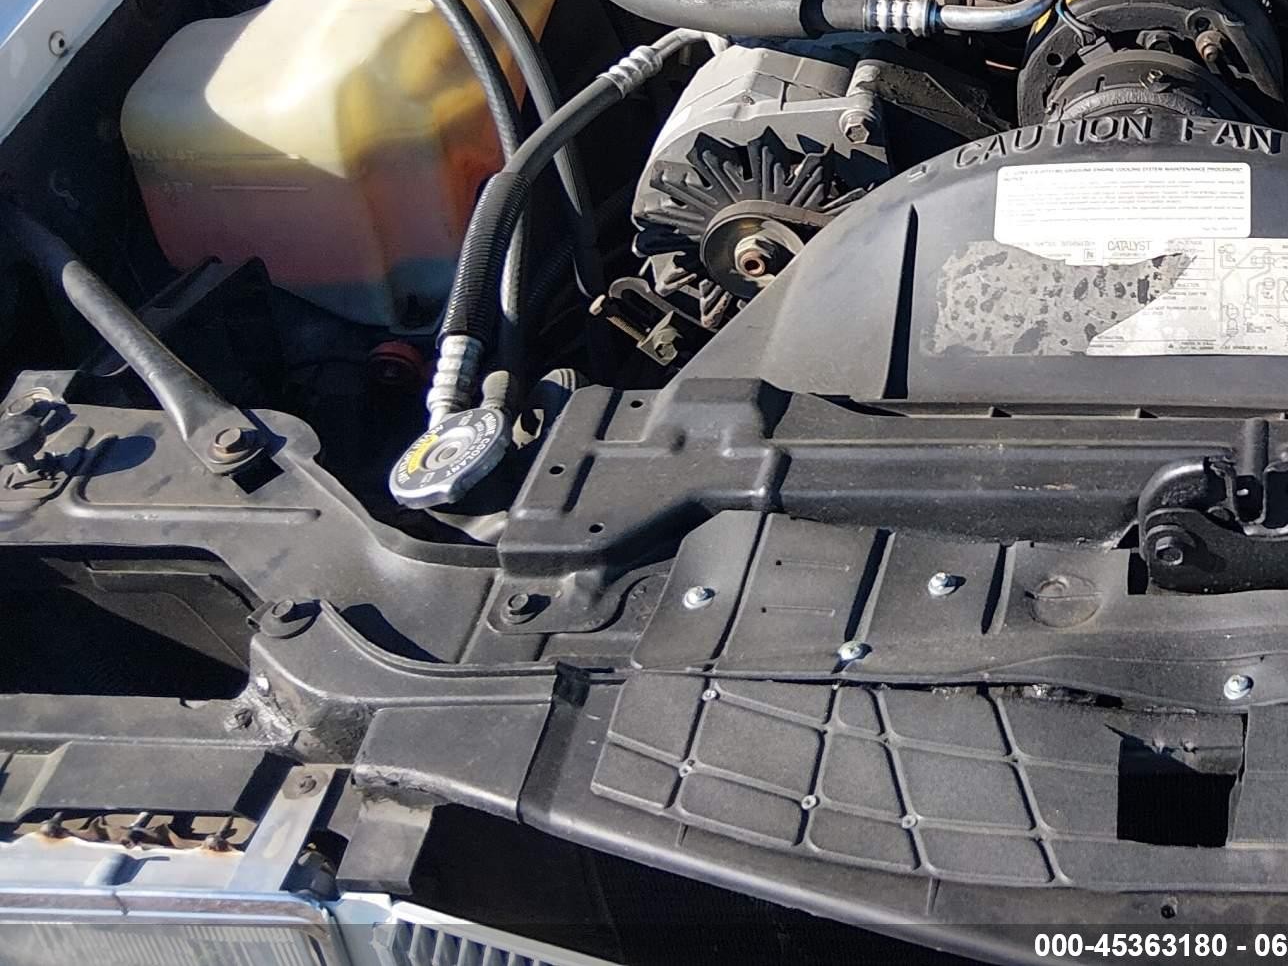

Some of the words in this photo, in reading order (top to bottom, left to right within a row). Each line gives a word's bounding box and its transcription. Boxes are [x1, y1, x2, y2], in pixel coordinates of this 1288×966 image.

[955, 114, 1153, 170] CAUTION
[1180, 117, 1282, 156] FAN
[1107, 240, 1153, 251] CATALYST
[445, 438, 490, 477] COOLANT
